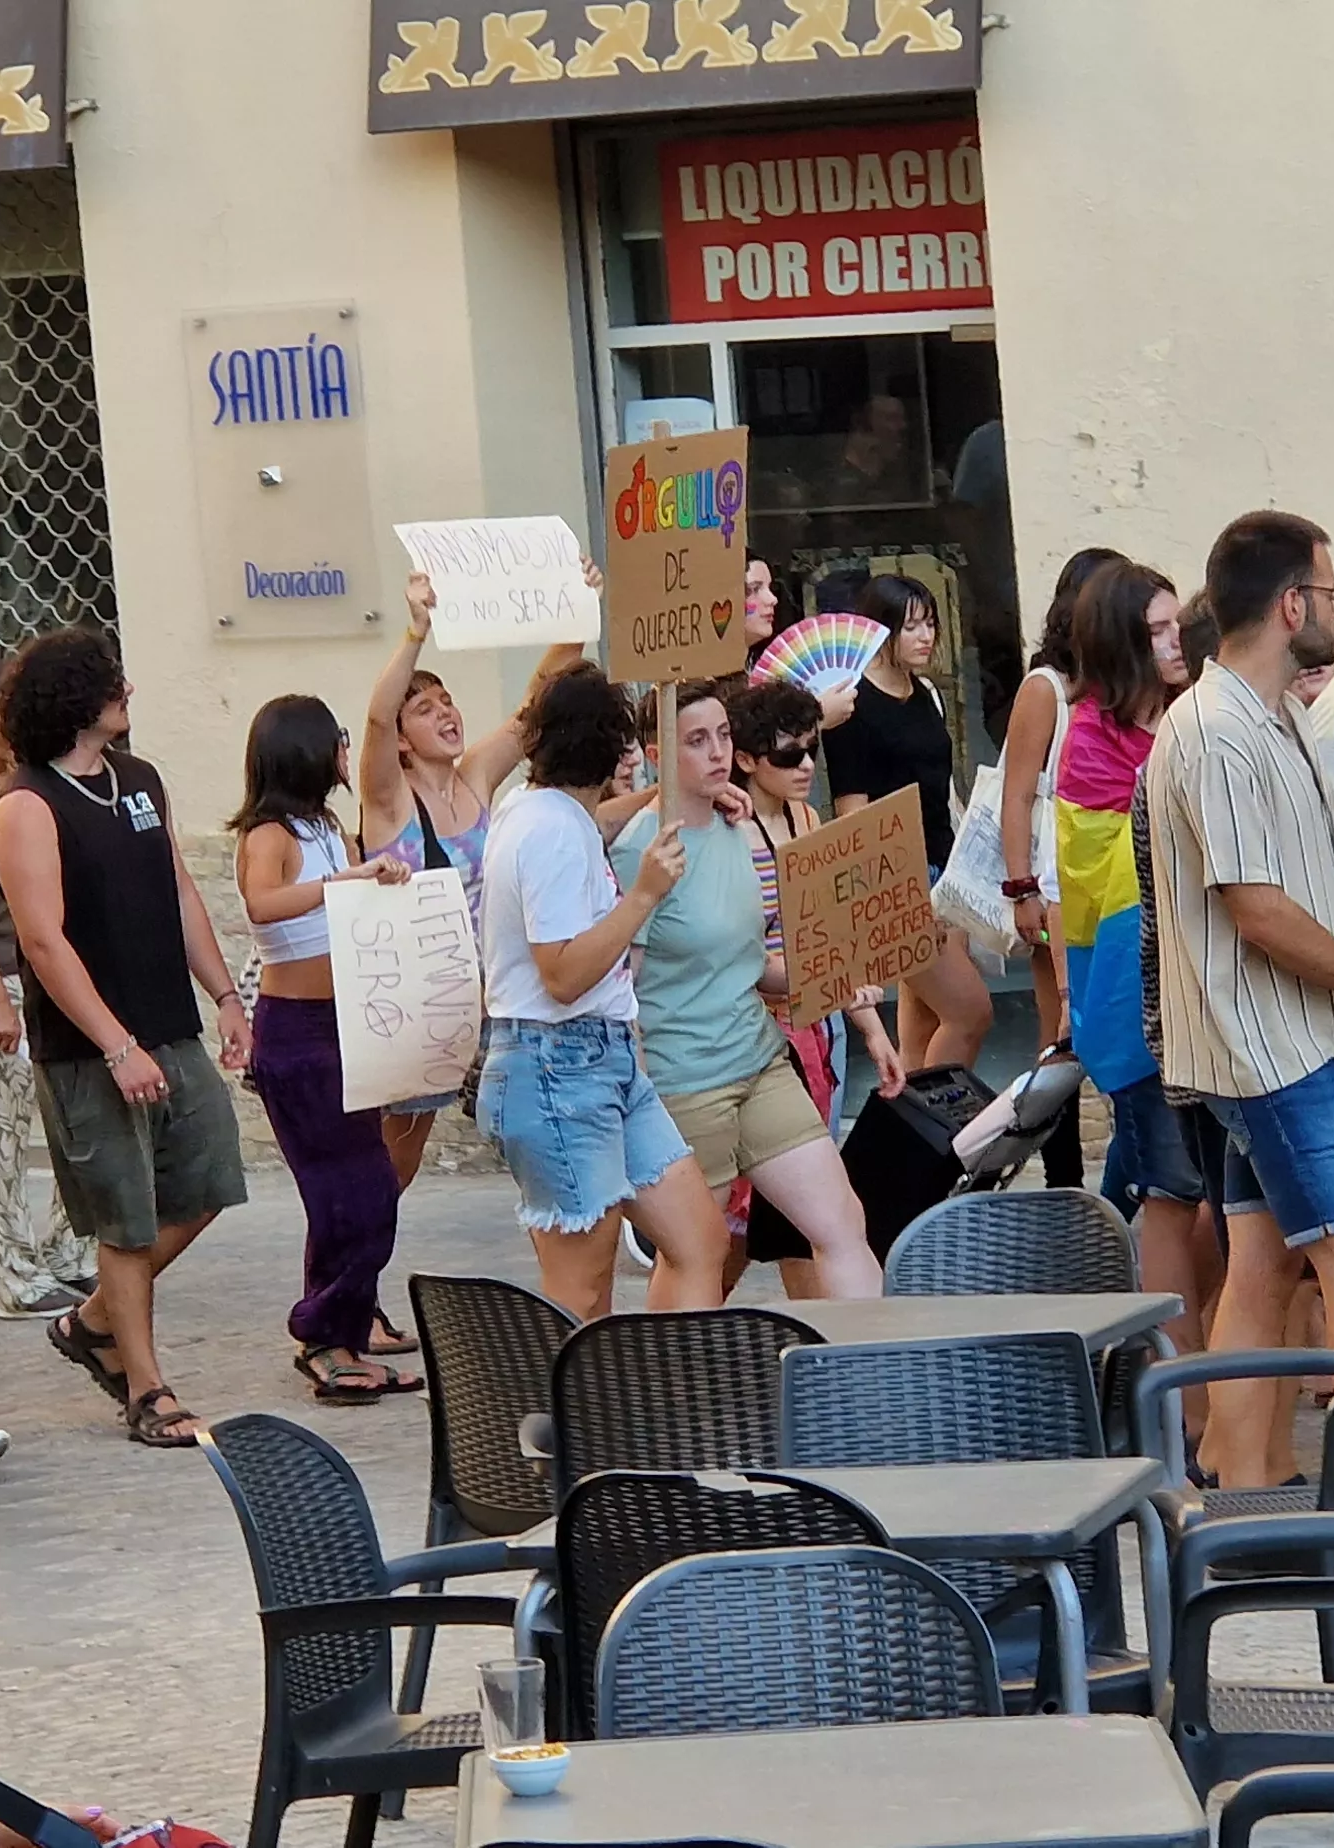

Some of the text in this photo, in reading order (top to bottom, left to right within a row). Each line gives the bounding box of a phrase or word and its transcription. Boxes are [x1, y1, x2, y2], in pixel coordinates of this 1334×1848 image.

[701, 242, 811, 303] POR
[209, 332, 349, 426] SANTÍA
[615, 453, 744, 549] ORGULLO
[244, 560, 346, 600] Decoración
[664, 548, 691, 595] DE
[473, 600, 501, 621] NO
[632, 602, 703, 659] QUERER
[785, 813, 904, 883] PORQUE LA
[417, 880, 447, 905] EL
[795, 919, 829, 954] ES
[851, 876, 923, 932] PODER
[800, 946, 845, 987] SER
[819, 972, 856, 1011] SIN
